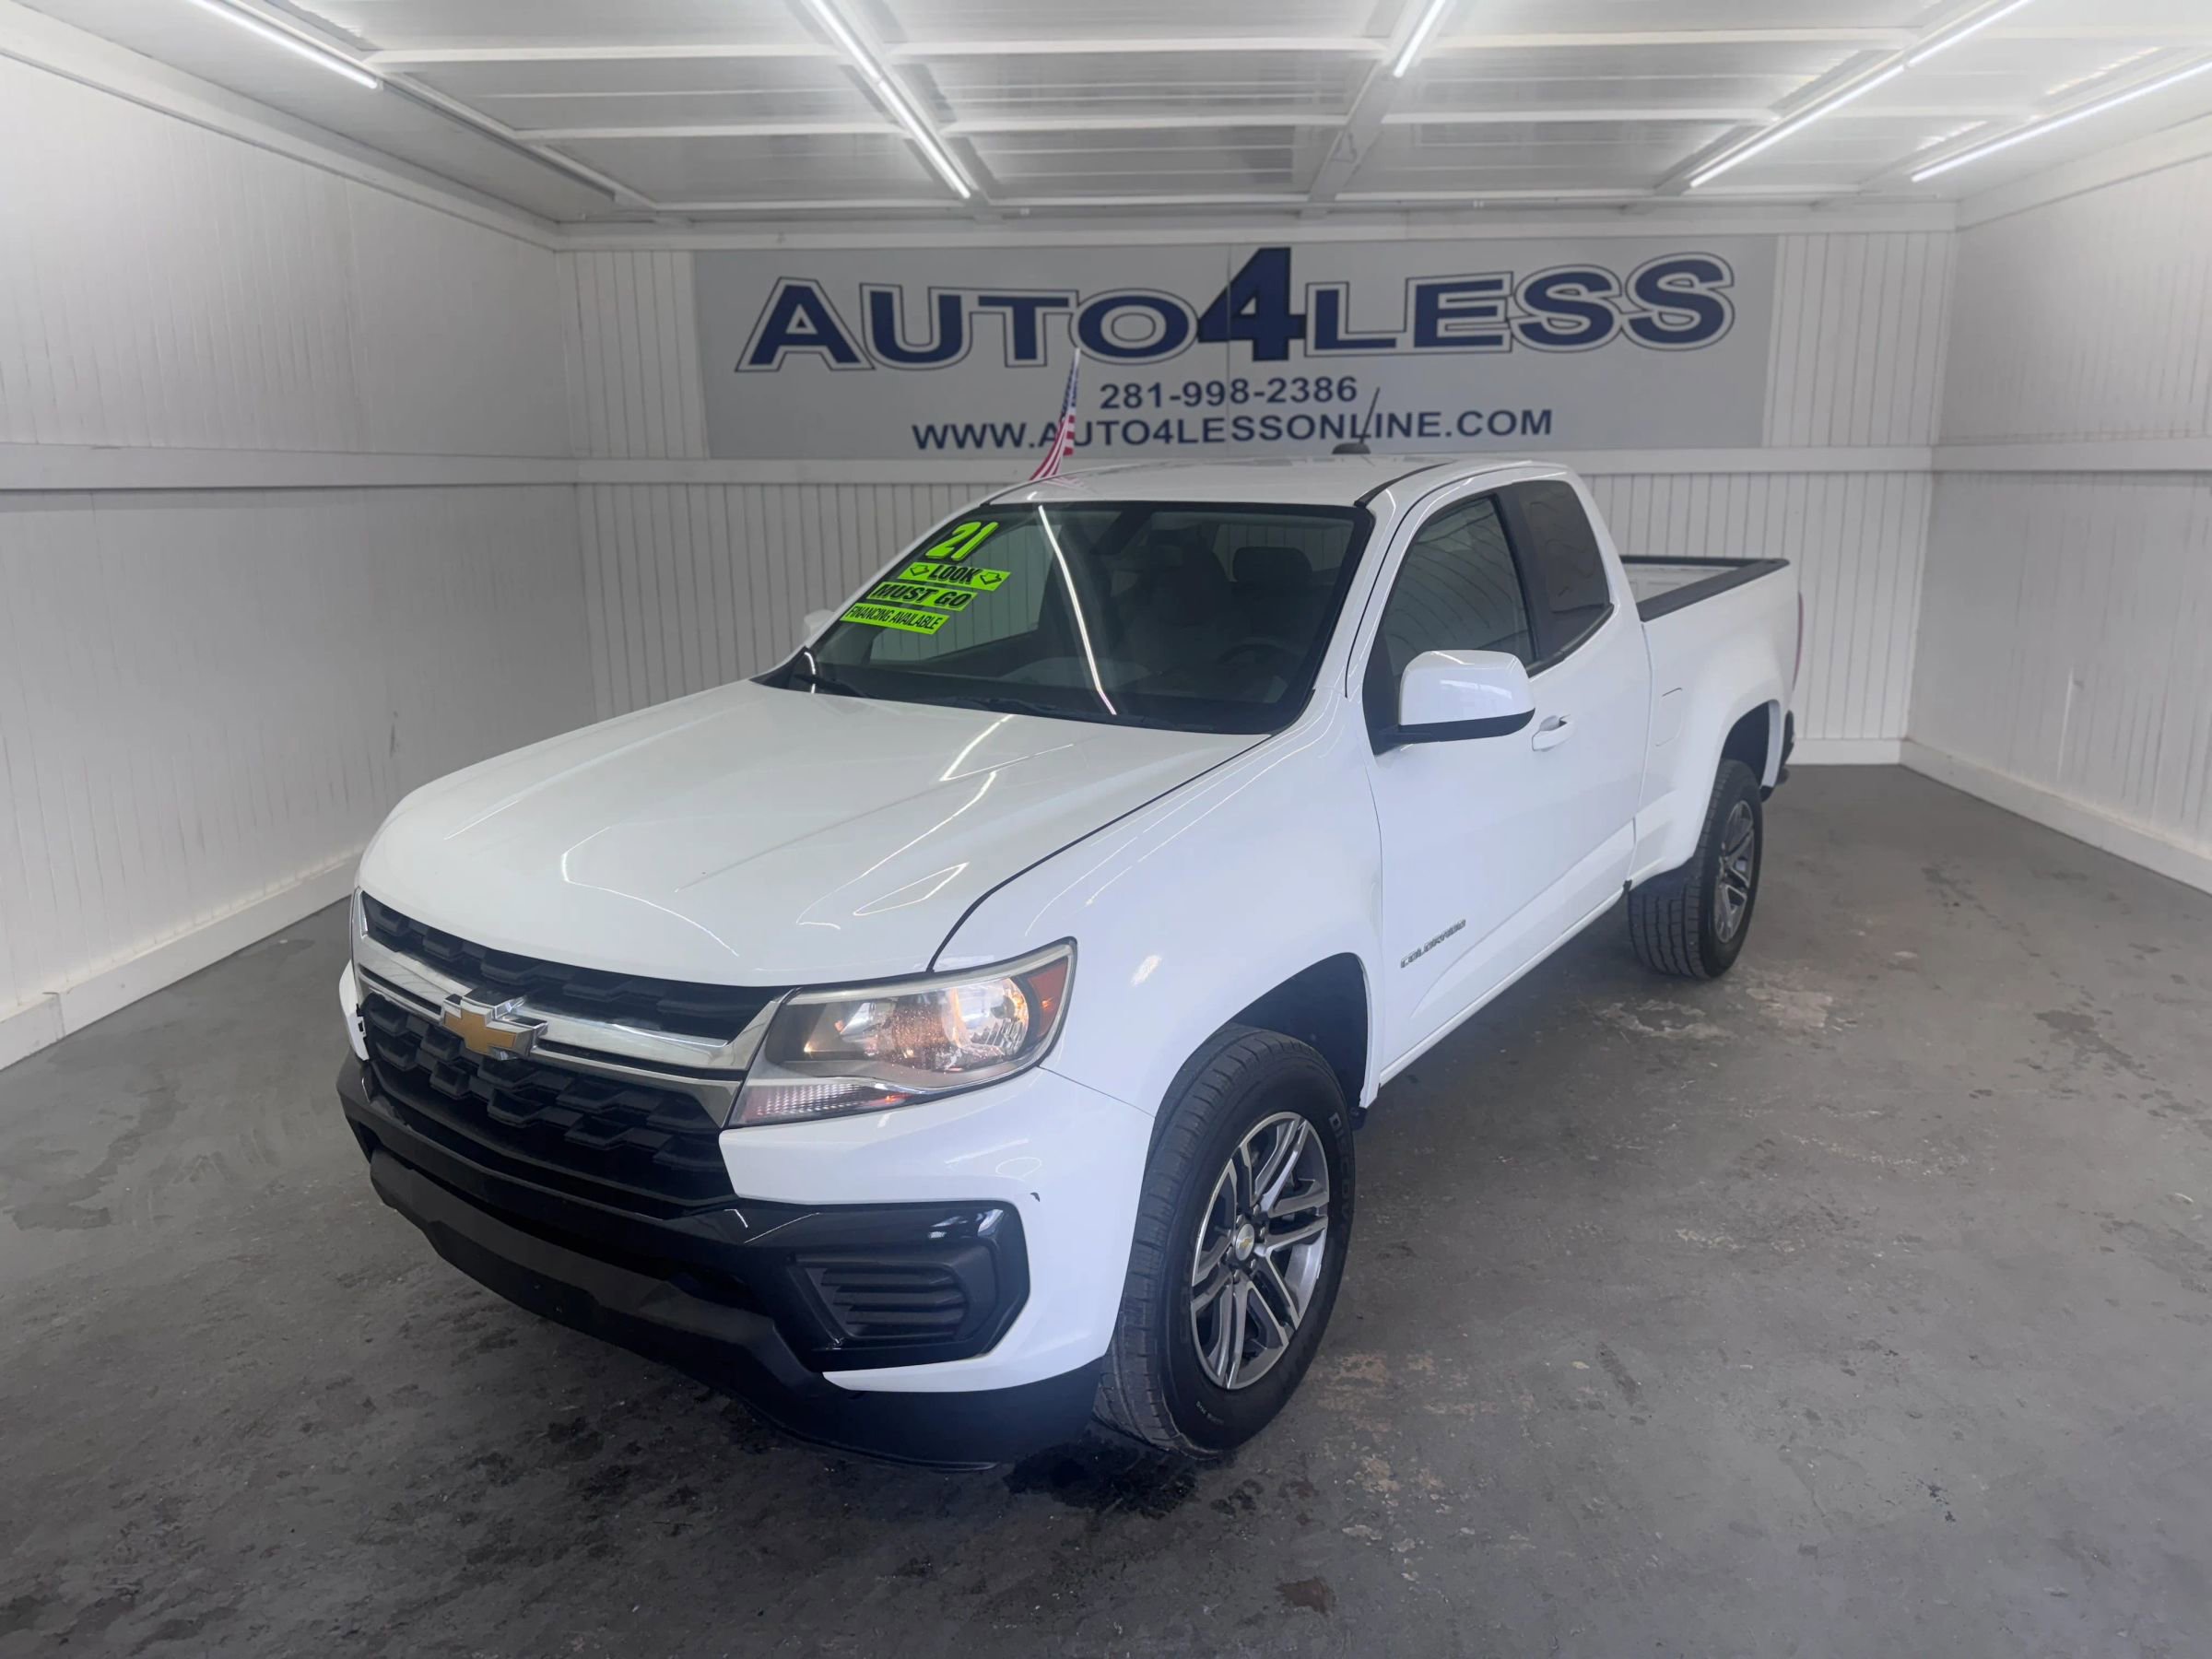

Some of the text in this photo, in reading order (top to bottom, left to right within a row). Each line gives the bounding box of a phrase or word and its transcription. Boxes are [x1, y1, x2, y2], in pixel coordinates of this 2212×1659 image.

[1100, 375, 1357, 410] 281-998-2386
[924, 521, 999, 561] 21
[928, 564, 982, 585] LOOK
[876, 583, 972, 608] MUST GO
[845, 606, 943, 630] FINANCING AVAILABLE
